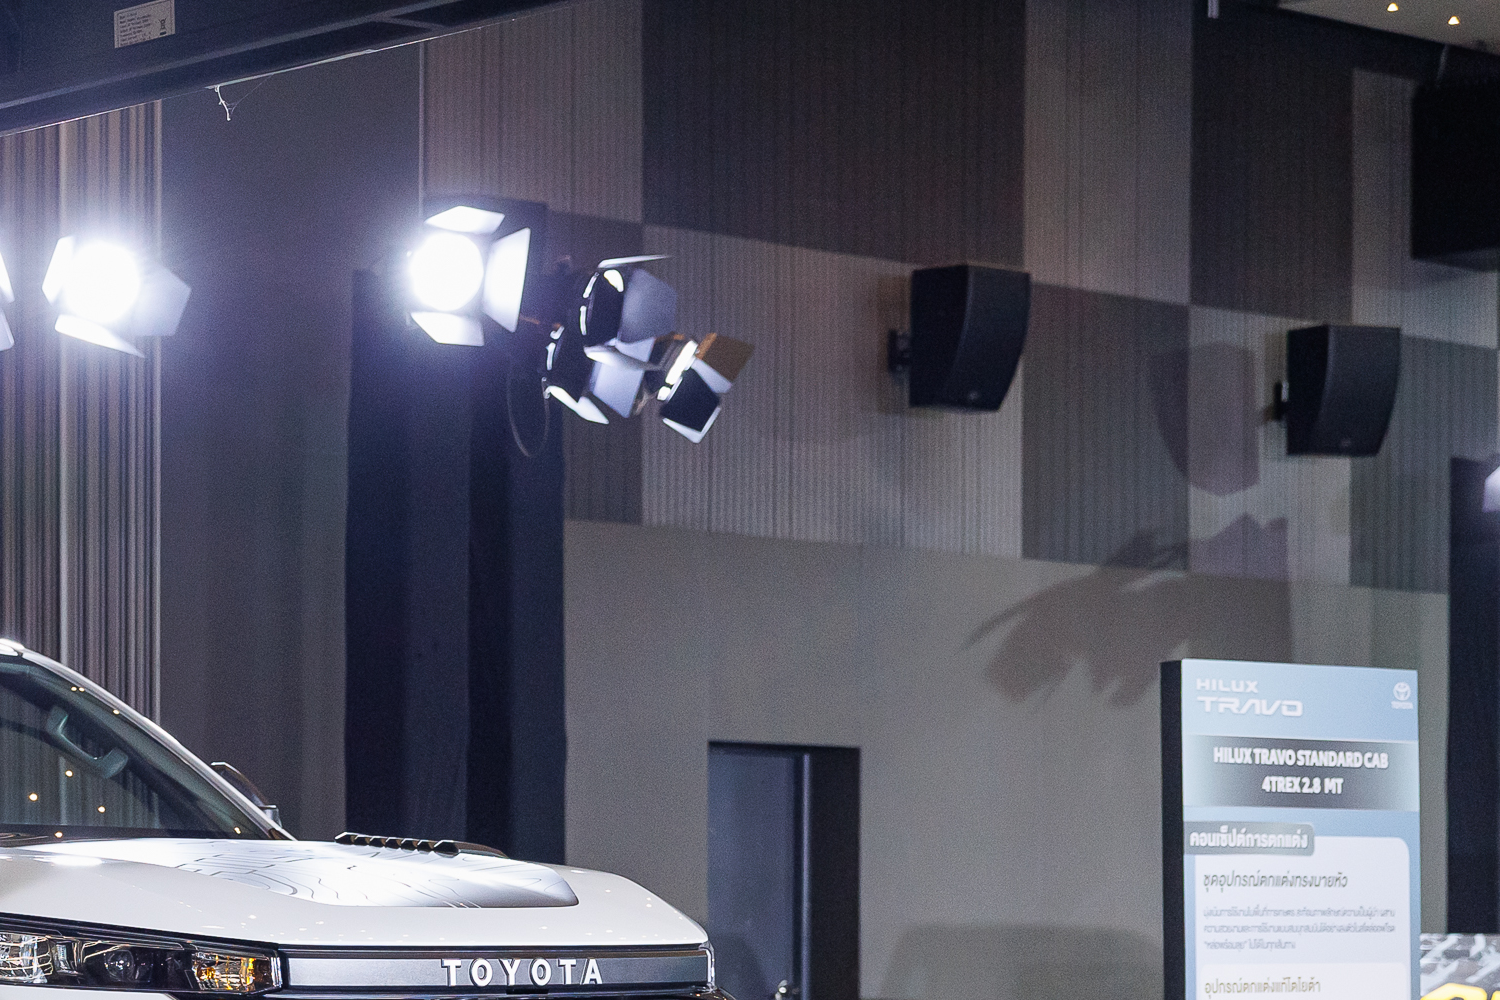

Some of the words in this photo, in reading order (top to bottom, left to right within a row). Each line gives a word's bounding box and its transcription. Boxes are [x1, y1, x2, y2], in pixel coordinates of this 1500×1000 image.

[1196, 678, 1258, 694] HILUX
[1196, 696, 1303, 717] TRAVO
[1213, 747, 1252, 765] HILUX
[1254, 749, 1296, 766] TRAVO
[1296, 750, 1363, 768] STANDARD
[1363, 752, 1389, 770] CAB
[1261, 776, 1301, 793] 4TREX
[1301, 777, 1321, 794] 2.8
[1323, 777, 1344, 794] MT
[441, 958, 603, 987] TOYOTA
